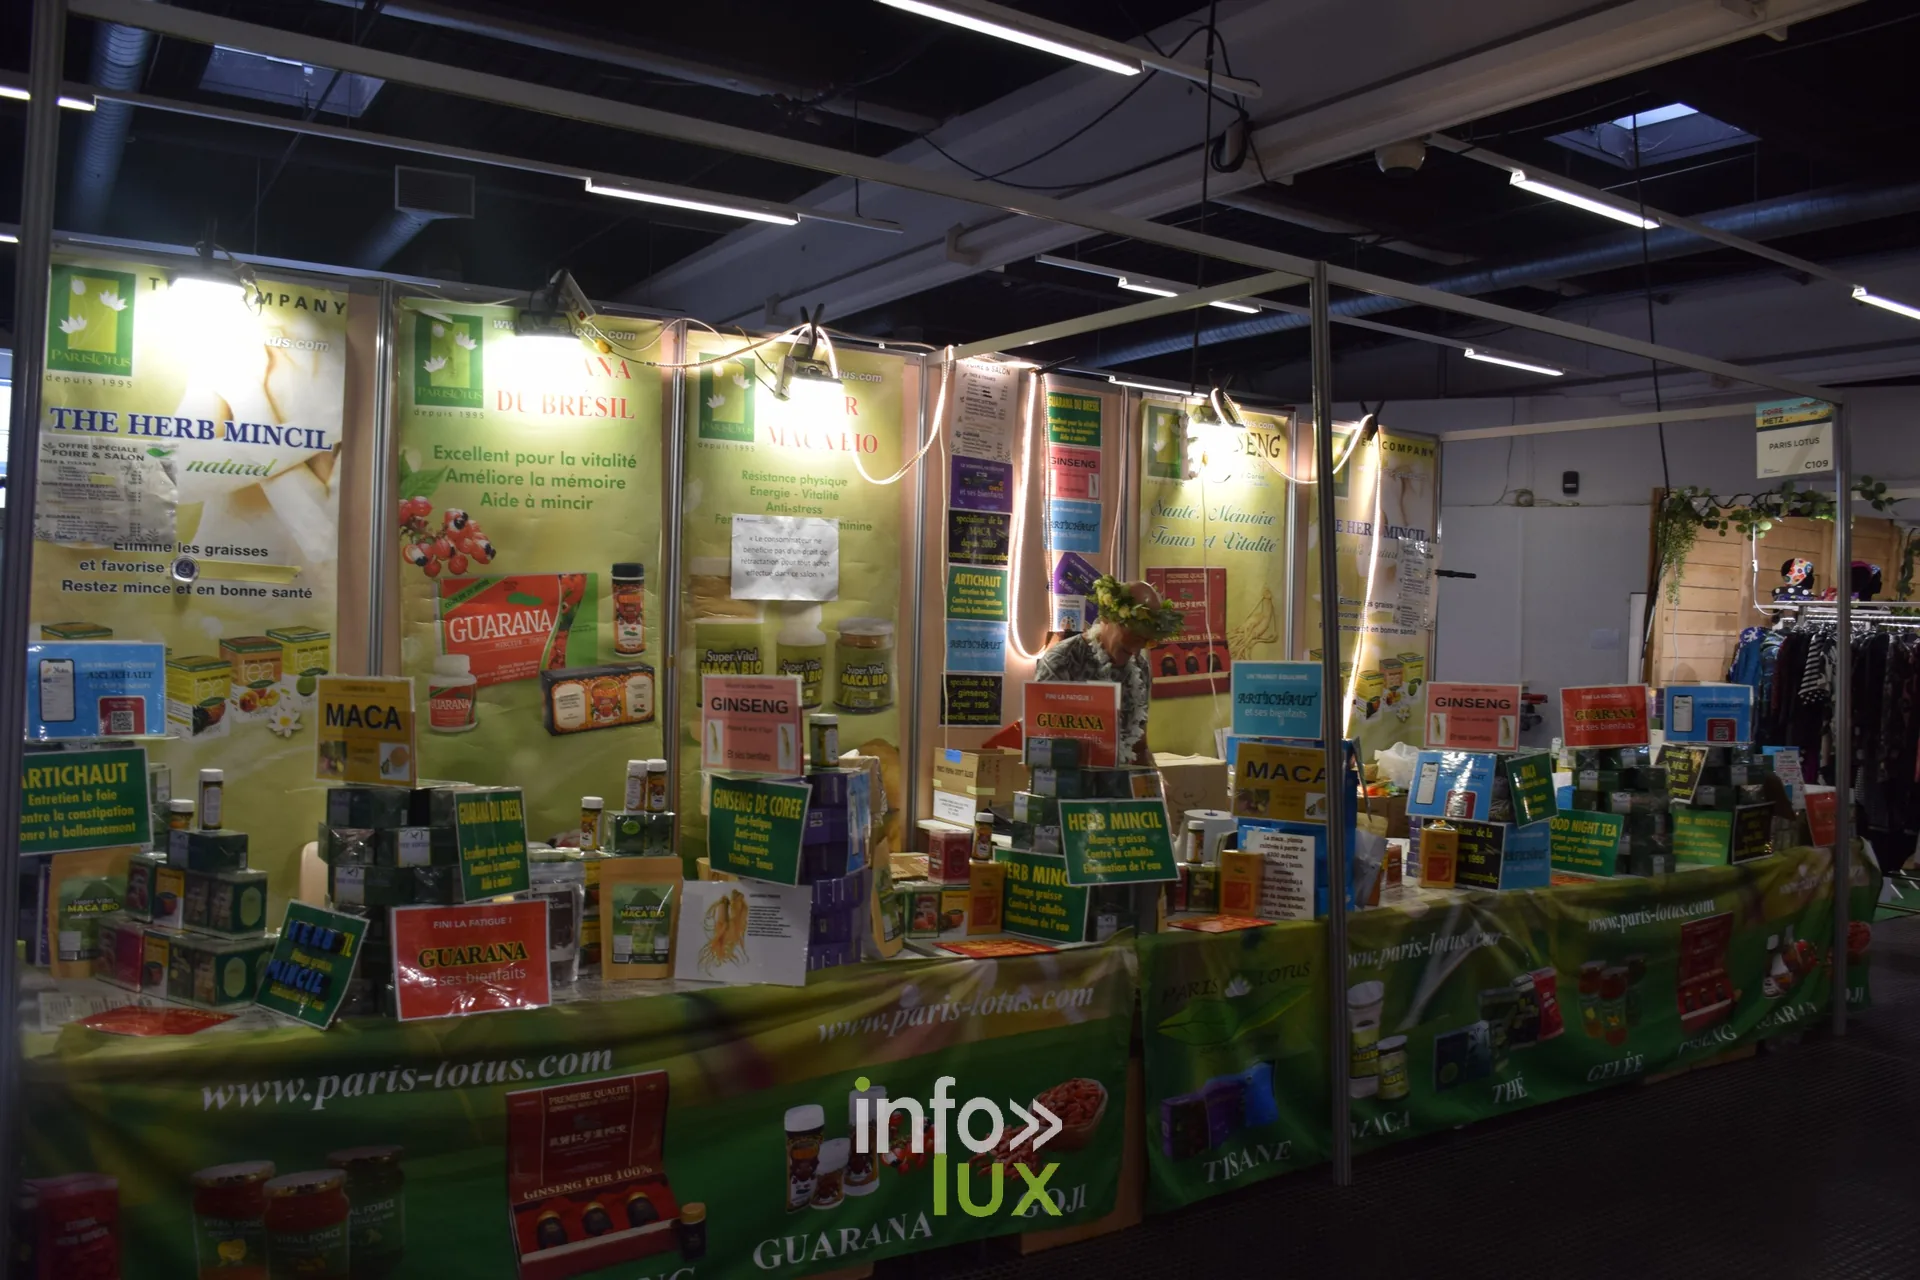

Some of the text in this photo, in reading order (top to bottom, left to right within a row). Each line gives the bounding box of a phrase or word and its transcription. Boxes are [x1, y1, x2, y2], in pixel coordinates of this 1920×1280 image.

[46, 375, 133, 389] depuis 1995
[541, 389, 635, 420] BRÉSIL
[1762, 407, 1783, 416] FOIRE
[414, 409, 484, 420] depuis 1995
[1762, 416, 1784, 425] METZ
[50, 406, 333, 451] THE HERB MINCIL
[58, 442, 138, 453] OFFRE SPÉCIALE
[1382, 440, 1434, 457] COMPANY
[1769, 437, 1820, 451] PARIS LOTUS
[51, 449, 144, 462] FOIRE & SALON
[434, 444, 637, 468] Excellent pour la vitalité
[186, 457, 278, 478] naturel
[1805, 459, 1829, 470] C109
[445, 467, 626, 490] Améliore la mémoire
[742, 470, 848, 487] Résistance physique
[480, 491, 594, 510] Aide à mincir
[750, 486, 840, 501] Energie Vitalité
[765, 501, 823, 515] Anti-stress
[1208, 504, 1276, 526] Mémoire
[177, 541, 269, 558] les graisses
[1224, 533, 1281, 553] Vitalité
[80, 559, 165, 573] et favorise
[955, 573, 1002, 587] ARTICHAUT
[62, 579, 313, 599] Restez mince et en bonne santé
[450, 608, 552, 644] GUARANA
[293, 649, 323, 670] tea
[707, 648, 758, 663] Super Vital
[241, 659, 275, 683] tea
[700, 660, 763, 675] MACA BIO
[847, 662, 884, 675] Super Vital
[841, 672, 888, 687] MACA BIO
[711, 696, 789, 714] GINSENG
[1238, 690, 1318, 707] ARTICHAUT
[1435, 696, 1511, 710] GINSENG
[326, 702, 402, 731] MACA
[1036, 713, 1104, 730] GUARANA
[1245, 708, 1254, 717] et
[1270, 707, 1308, 719] bienfaits
[1574, 707, 1637, 721] GUARANA
[28, 788, 117, 807] Entretien le foie
[713, 788, 803, 820] GINSENG DE COREE
[53, 805, 135, 822] la constipation
[1067, 811, 1163, 832] HERB MINCIL
[62, 822, 137, 838] ballonnement
[1571, 819, 1617, 838] NIGHT TEA
[1117, 833, 1147, 847] graisse
[1129, 860, 1139, 872] de
[67, 902, 120, 914] MACA BIO
[621, 910, 648, 918] MACA
[1588, 899, 1716, 934] www.paris-lotus.com
[433, 917, 506, 930] FINI LA FATIGUE
[418, 941, 529, 969] GUARANA
[439, 974, 462, 987] ses
[467, 966, 527, 985] bienfaits
[1163, 961, 1310, 1003] PARIS LOTUS
[818, 984, 1094, 1045] www.paris-lotus.com
[201, 1047, 613, 1111] www.paris-lotus.com
[1492, 1071, 1528, 1103] THÉ
[548, 1084, 630, 1106] PREMIERE QUALITE
[1203, 1140, 1293, 1184] TISANE
[523, 1164, 653, 1201] GINSENG PUR 100%
[364, 1198, 395, 1215] FORCE
[309, 1228, 341, 1243] FORCE
[752, 1211, 934, 1271] GUARANA
